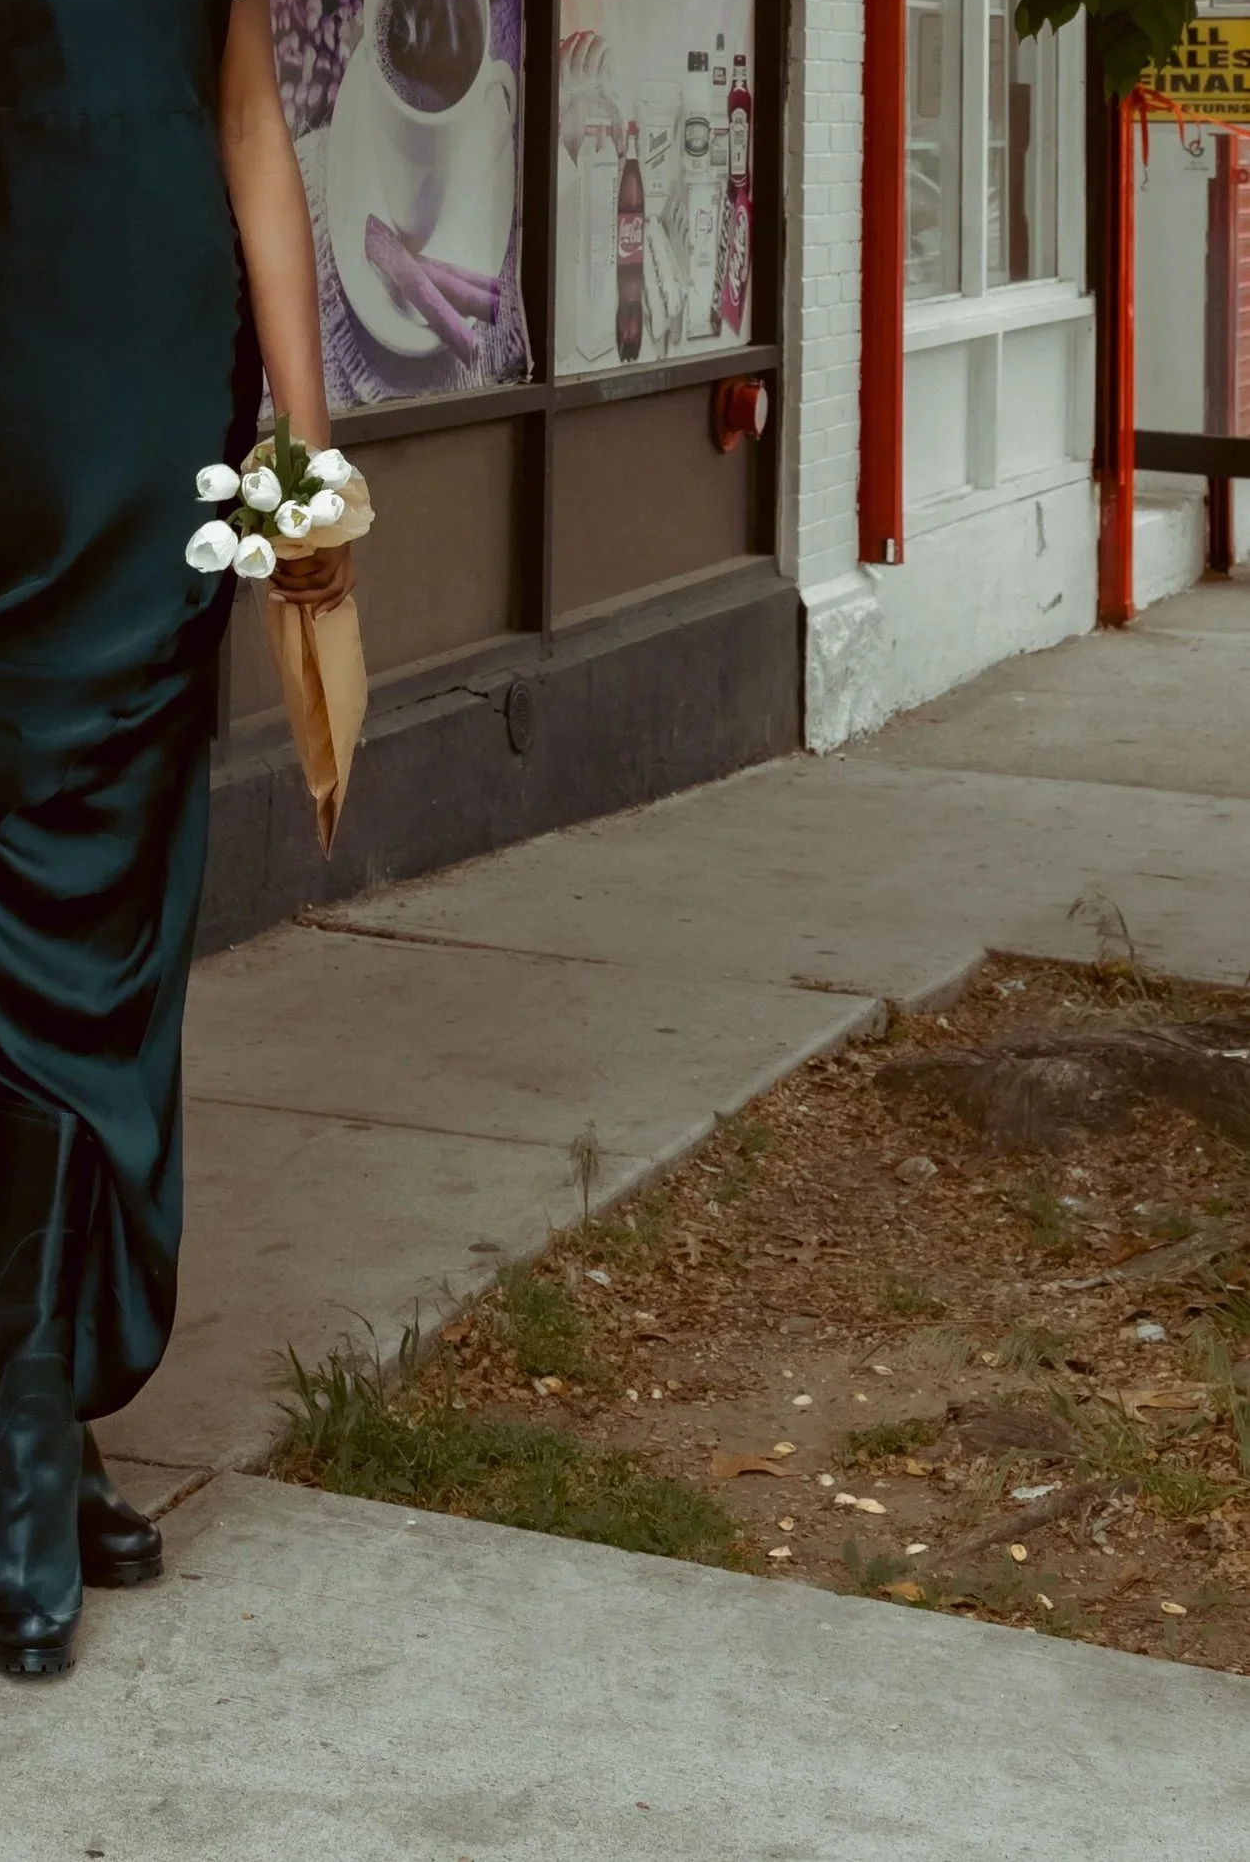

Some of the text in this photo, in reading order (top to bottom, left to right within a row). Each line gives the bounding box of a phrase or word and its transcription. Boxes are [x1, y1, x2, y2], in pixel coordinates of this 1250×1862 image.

[1181, 26, 1229, 46] LL
[1160, 49, 1250, 68] ALES
[1180, 102, 1250, 114] ETURNS
